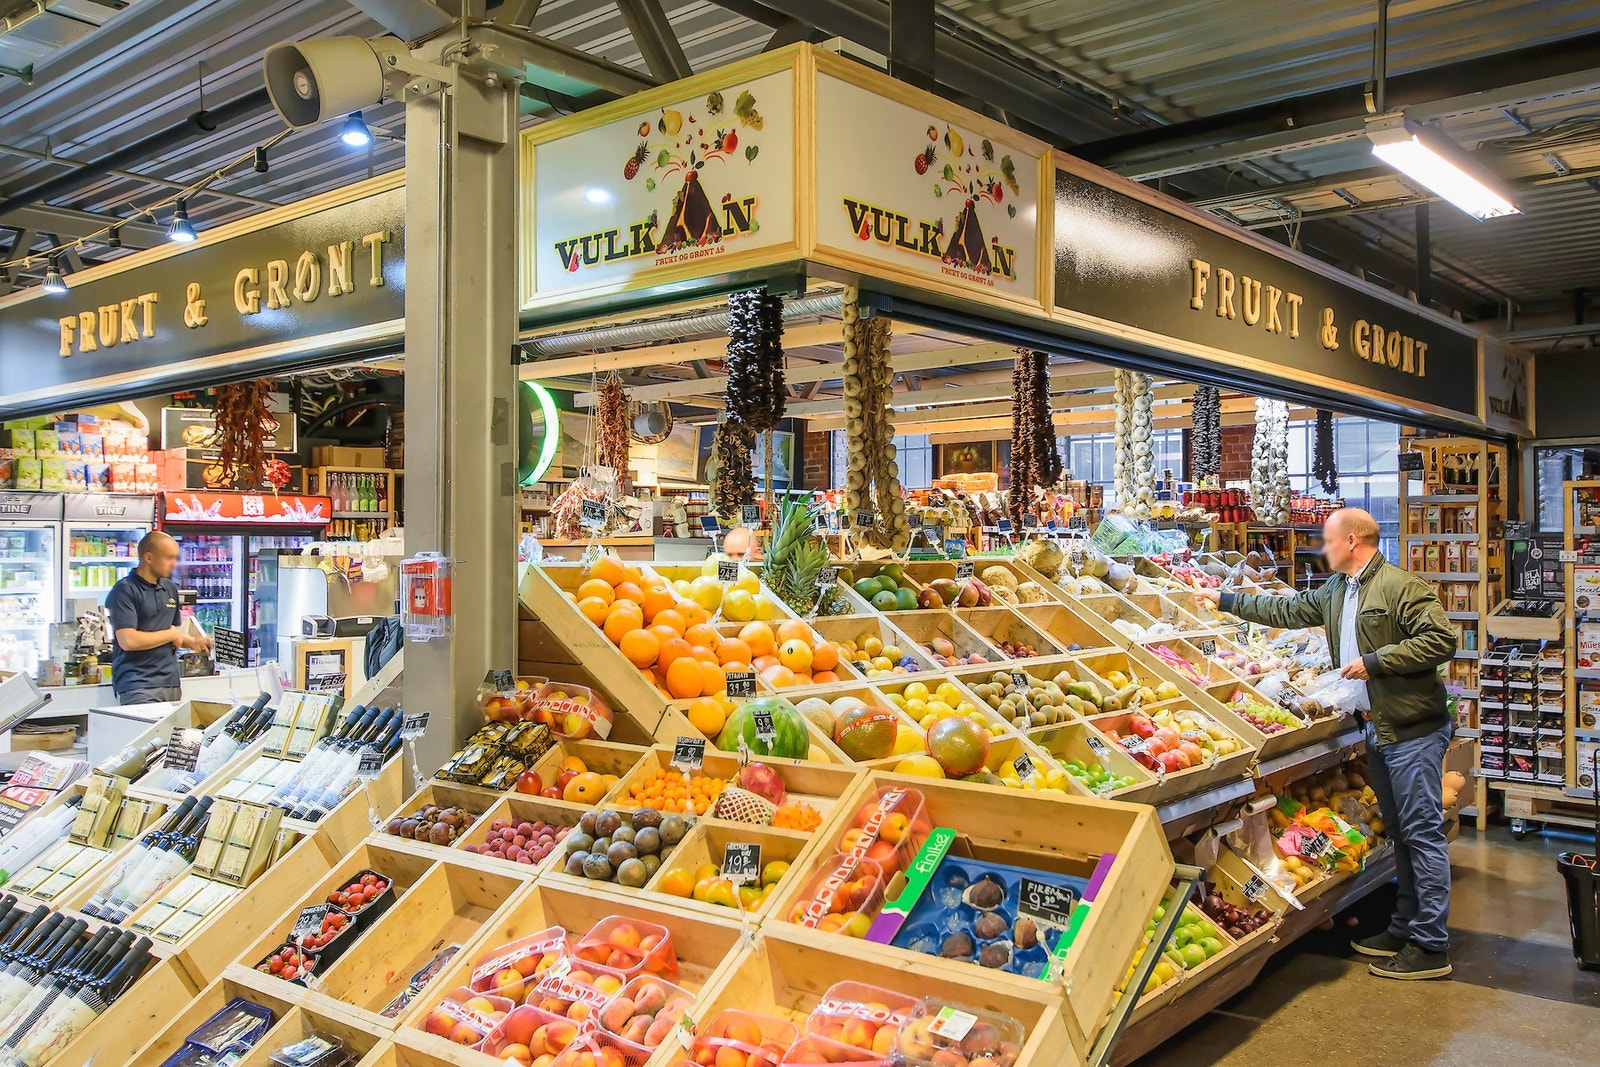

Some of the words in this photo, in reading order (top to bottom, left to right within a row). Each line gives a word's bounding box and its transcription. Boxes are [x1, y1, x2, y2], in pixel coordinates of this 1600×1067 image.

[554, 178, 757, 272] VULKAN
[843, 198, 1014, 279] VULKAN
[655, 256, 678, 266] FRUKT
[679, 253, 688, 261] OG
[715, 245, 725, 254] AS
[58, 291, 158, 357] FRUKT
[183, 282, 208, 328] &
[234, 231, 390, 315] GRØNT
[1190, 258, 1304, 339] FRUKT
[1321, 307, 1340, 350] &
[1354, 318, 1429, 377] GRØNT
[1, 504, 28, 513] TINE
[97, 506, 122, 515] TINE
[729, 683, 740, 696] 39
[7, 786, 39, 805] VG
[726, 854, 742, 874] 19
[1029, 892, 1041, 912] 9
